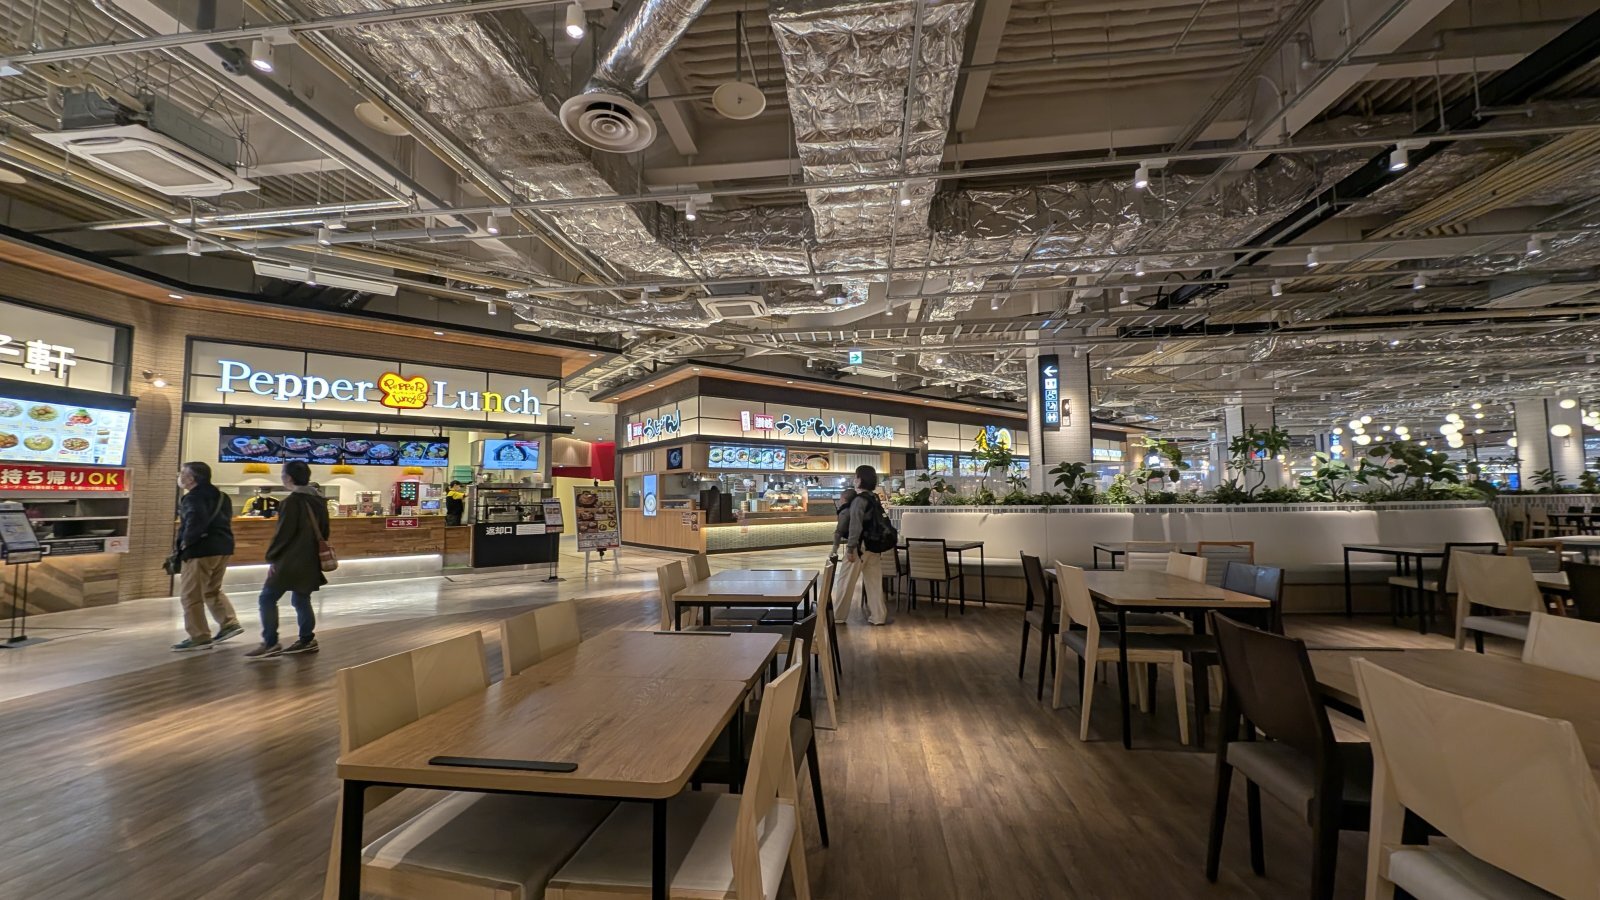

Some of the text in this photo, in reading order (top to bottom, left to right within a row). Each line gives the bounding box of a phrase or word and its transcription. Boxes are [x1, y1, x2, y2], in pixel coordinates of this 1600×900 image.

[216, 359, 541, 415] Pepper Lunch
[643, 409, 681, 439] うどん
[775, 414, 835, 438] うどん
[0, 469, 118, 485] 持ち帰りOK
[486, 526, 513, 536] 返却口
